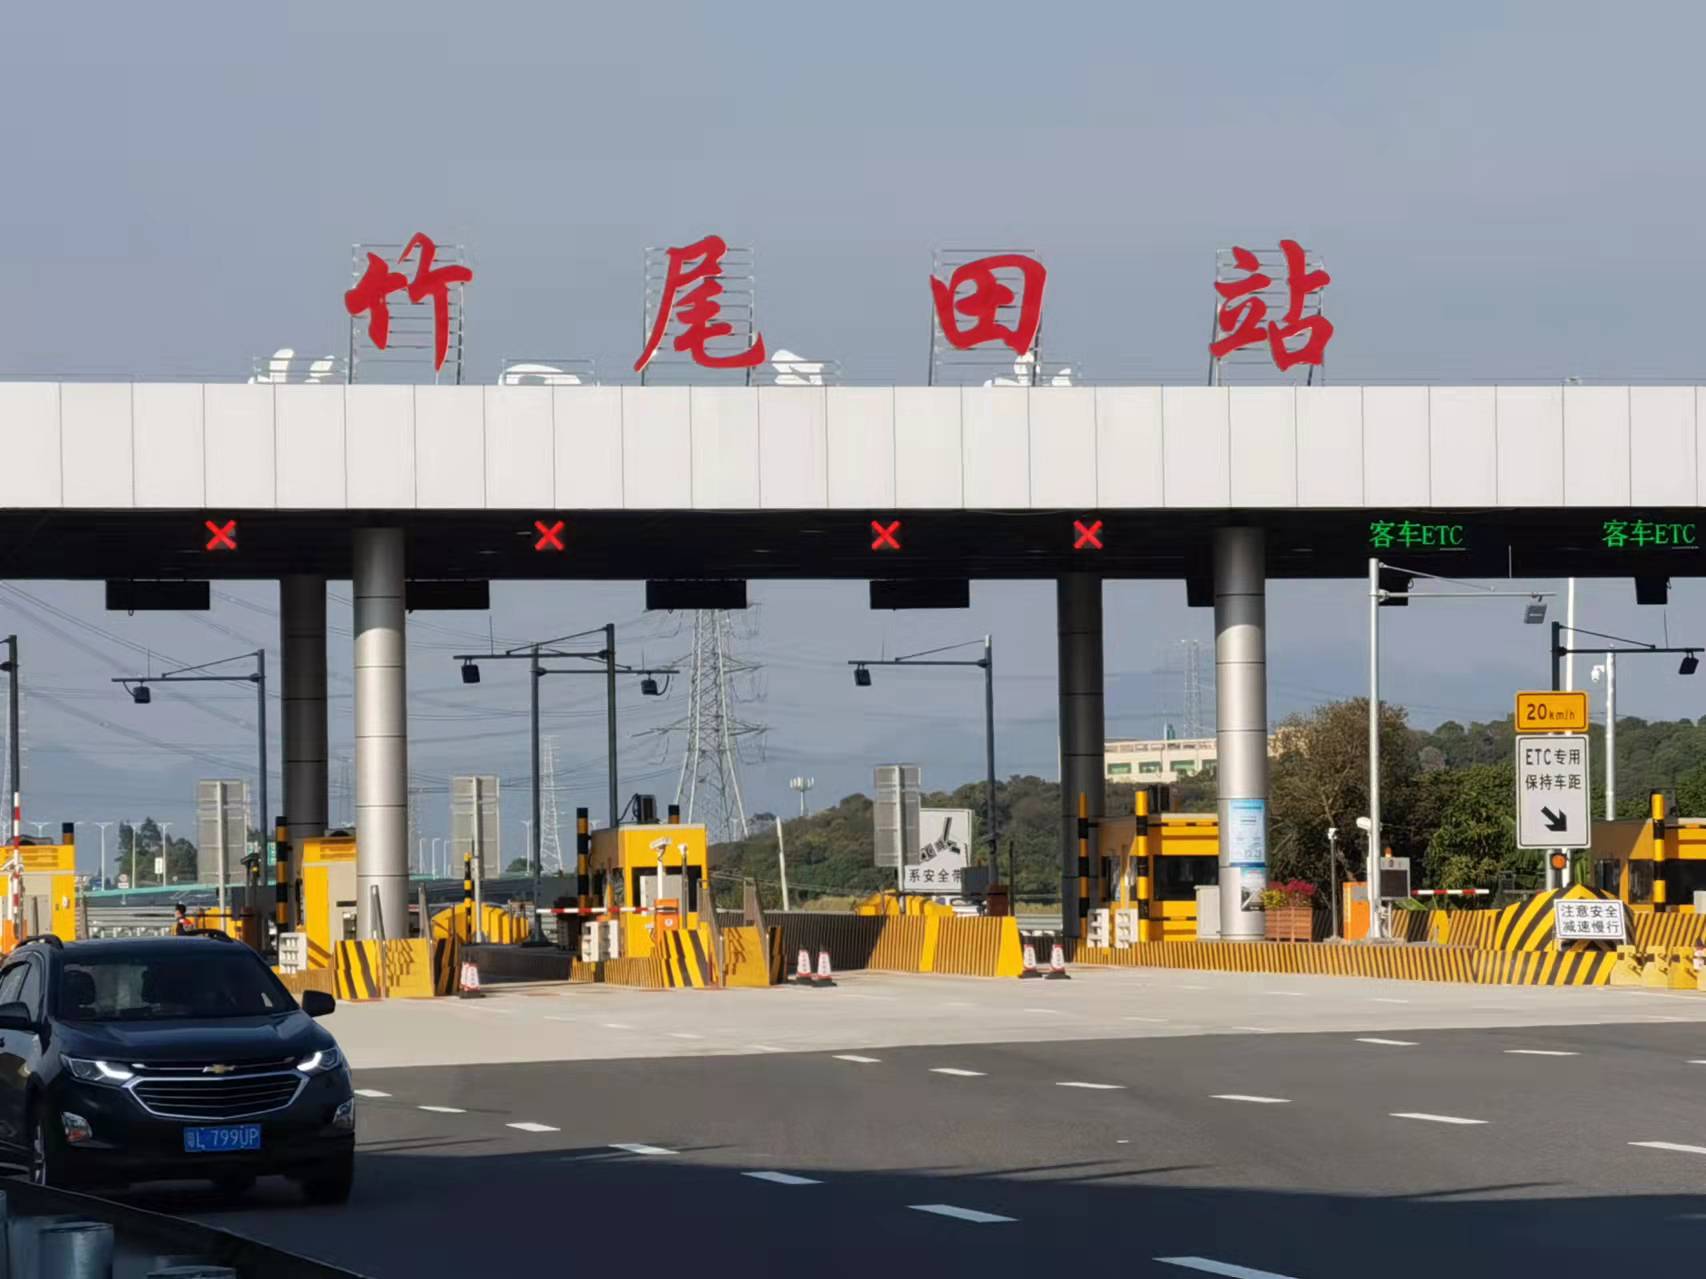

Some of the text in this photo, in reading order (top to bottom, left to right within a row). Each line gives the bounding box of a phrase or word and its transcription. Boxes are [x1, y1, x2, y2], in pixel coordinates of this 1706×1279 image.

[345, 232, 1333, 371] 竹尾田站
[1369, 520, 1464, 548] 客车ETC
[1602, 519, 1696, 547] 客车ETC
[1525, 748, 1581, 766] ETC专用
[1525, 774, 1582, 791] 保持车距
[1560, 905, 1618, 918] 注意安全
[1562, 920, 1620, 933] 减速慢行
